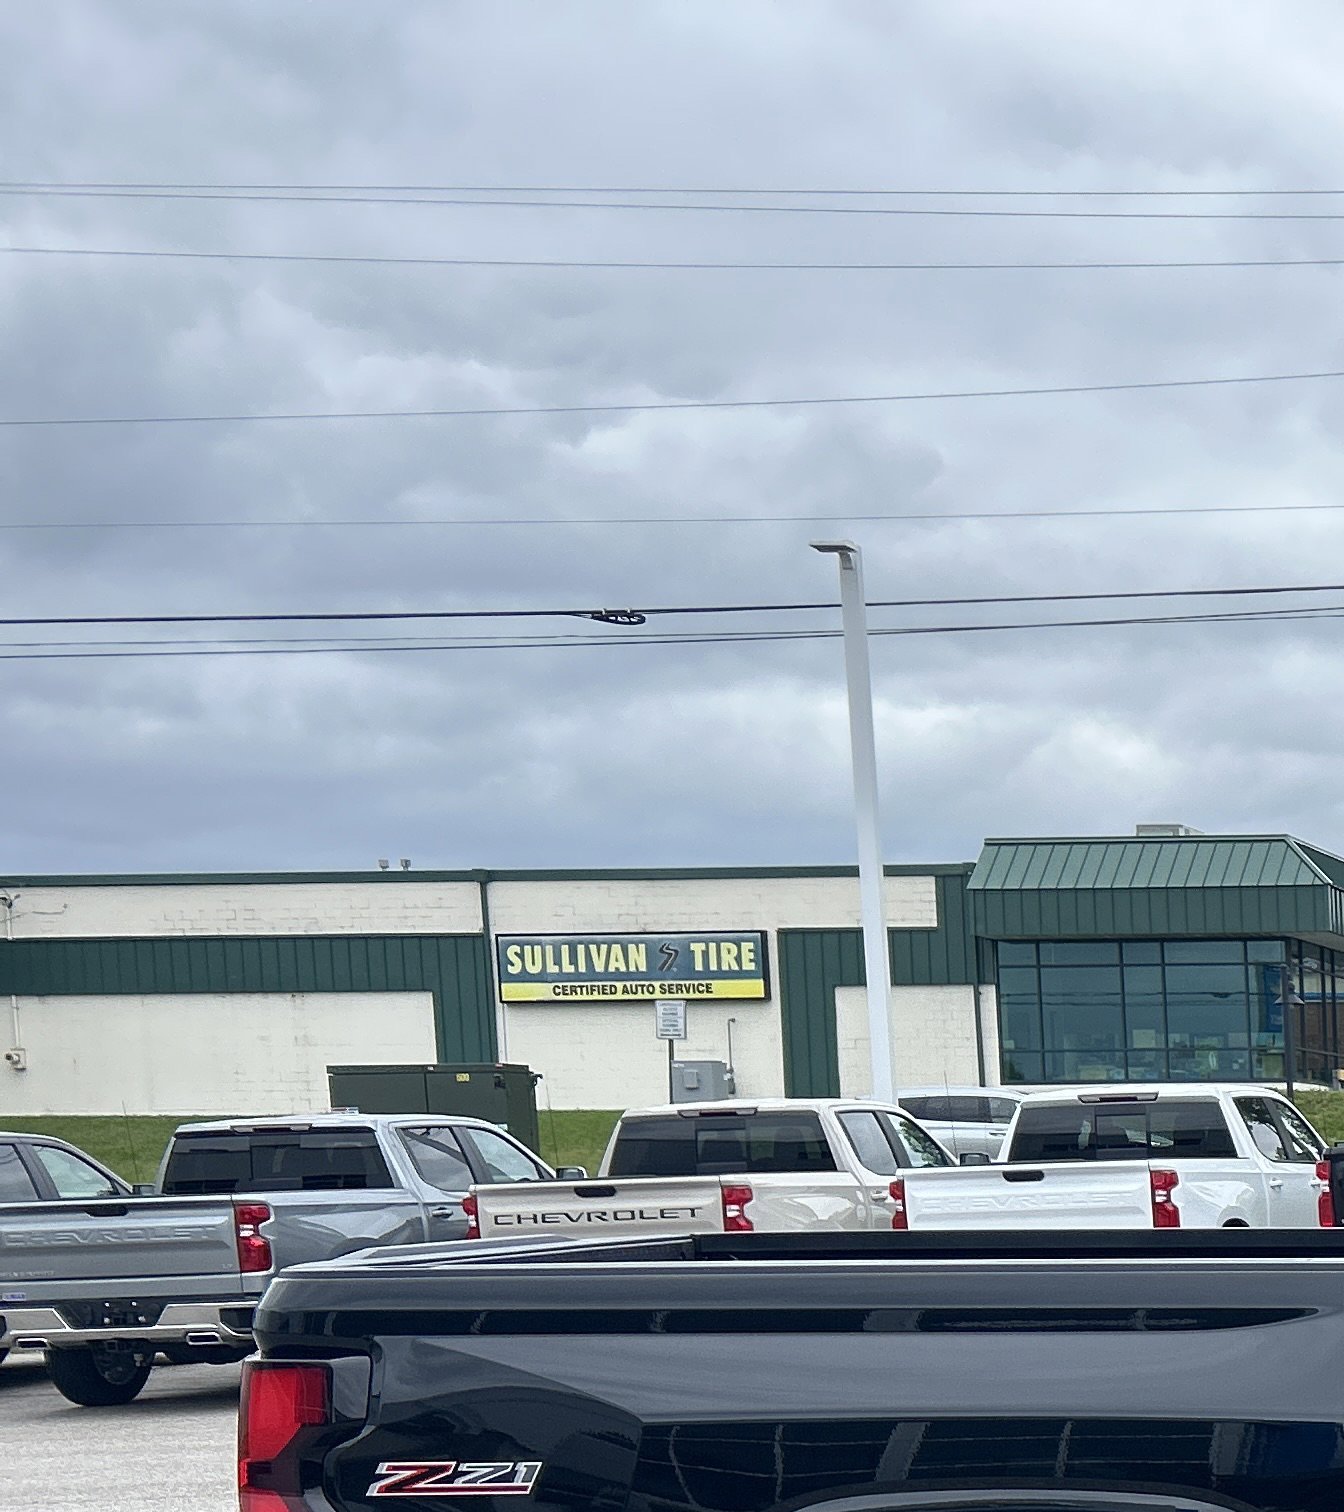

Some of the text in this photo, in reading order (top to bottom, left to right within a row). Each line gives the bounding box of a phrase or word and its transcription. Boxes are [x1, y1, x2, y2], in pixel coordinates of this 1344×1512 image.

[506, 941, 756, 975] SULLIVAN TIRE
[552, 982, 714, 997] CERTIFIED AUTO SERVICE
[493, 1206, 703, 1227] CHEVROLET
[4, 1225, 217, 1247] CHEVROLET
[365, 1460, 543, 1497] Z71
